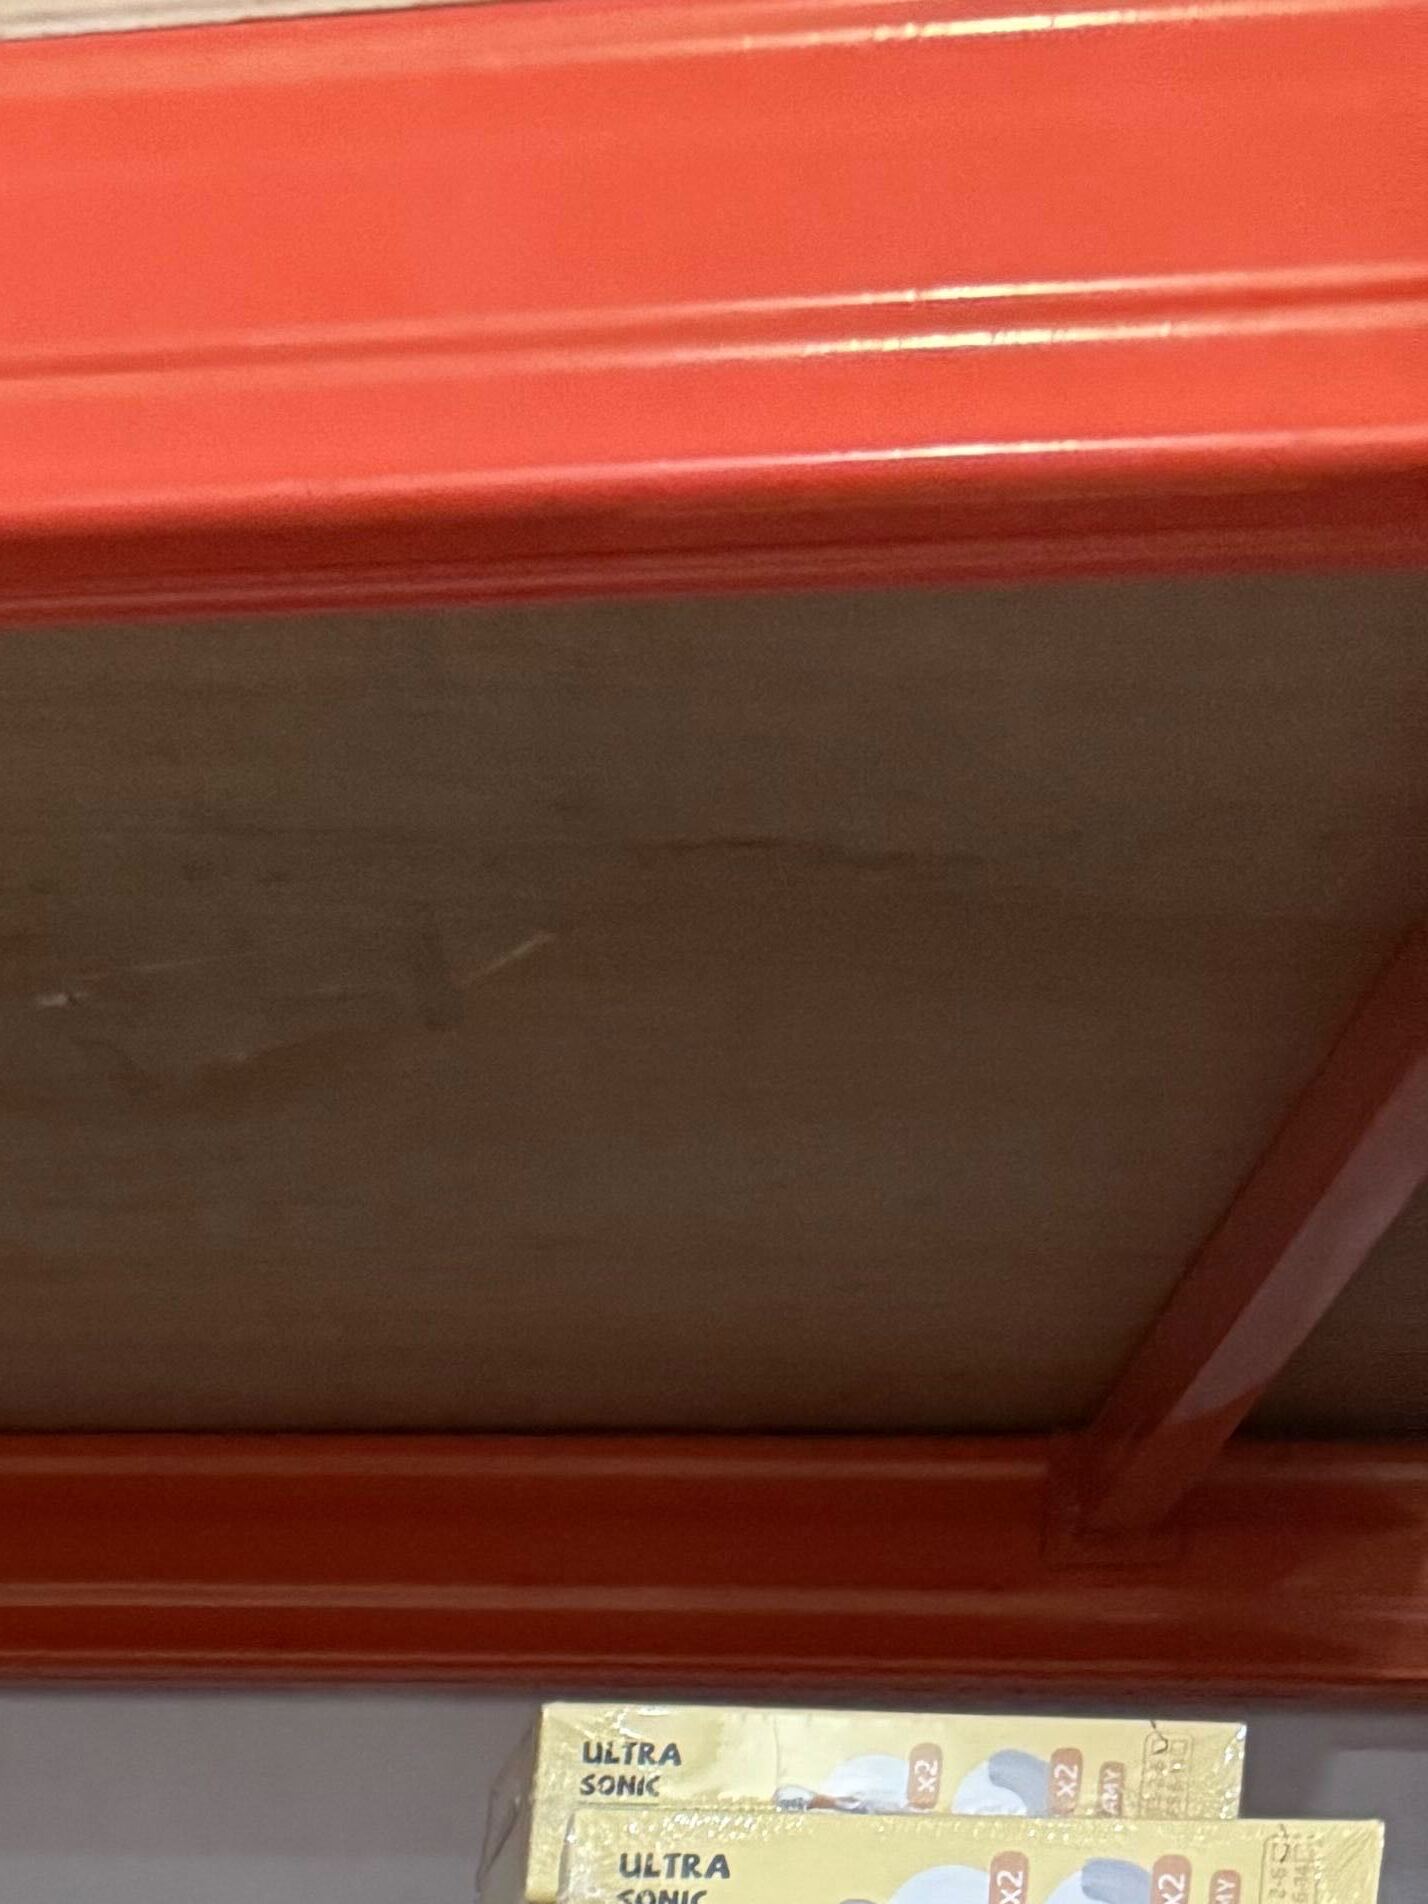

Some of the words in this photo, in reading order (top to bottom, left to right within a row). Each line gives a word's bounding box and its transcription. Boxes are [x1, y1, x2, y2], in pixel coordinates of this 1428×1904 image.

[581, 1741, 681, 1766] ULTRA
[579, 1774, 661, 1796] SONIC
[619, 1853, 730, 1879] ULTRA
